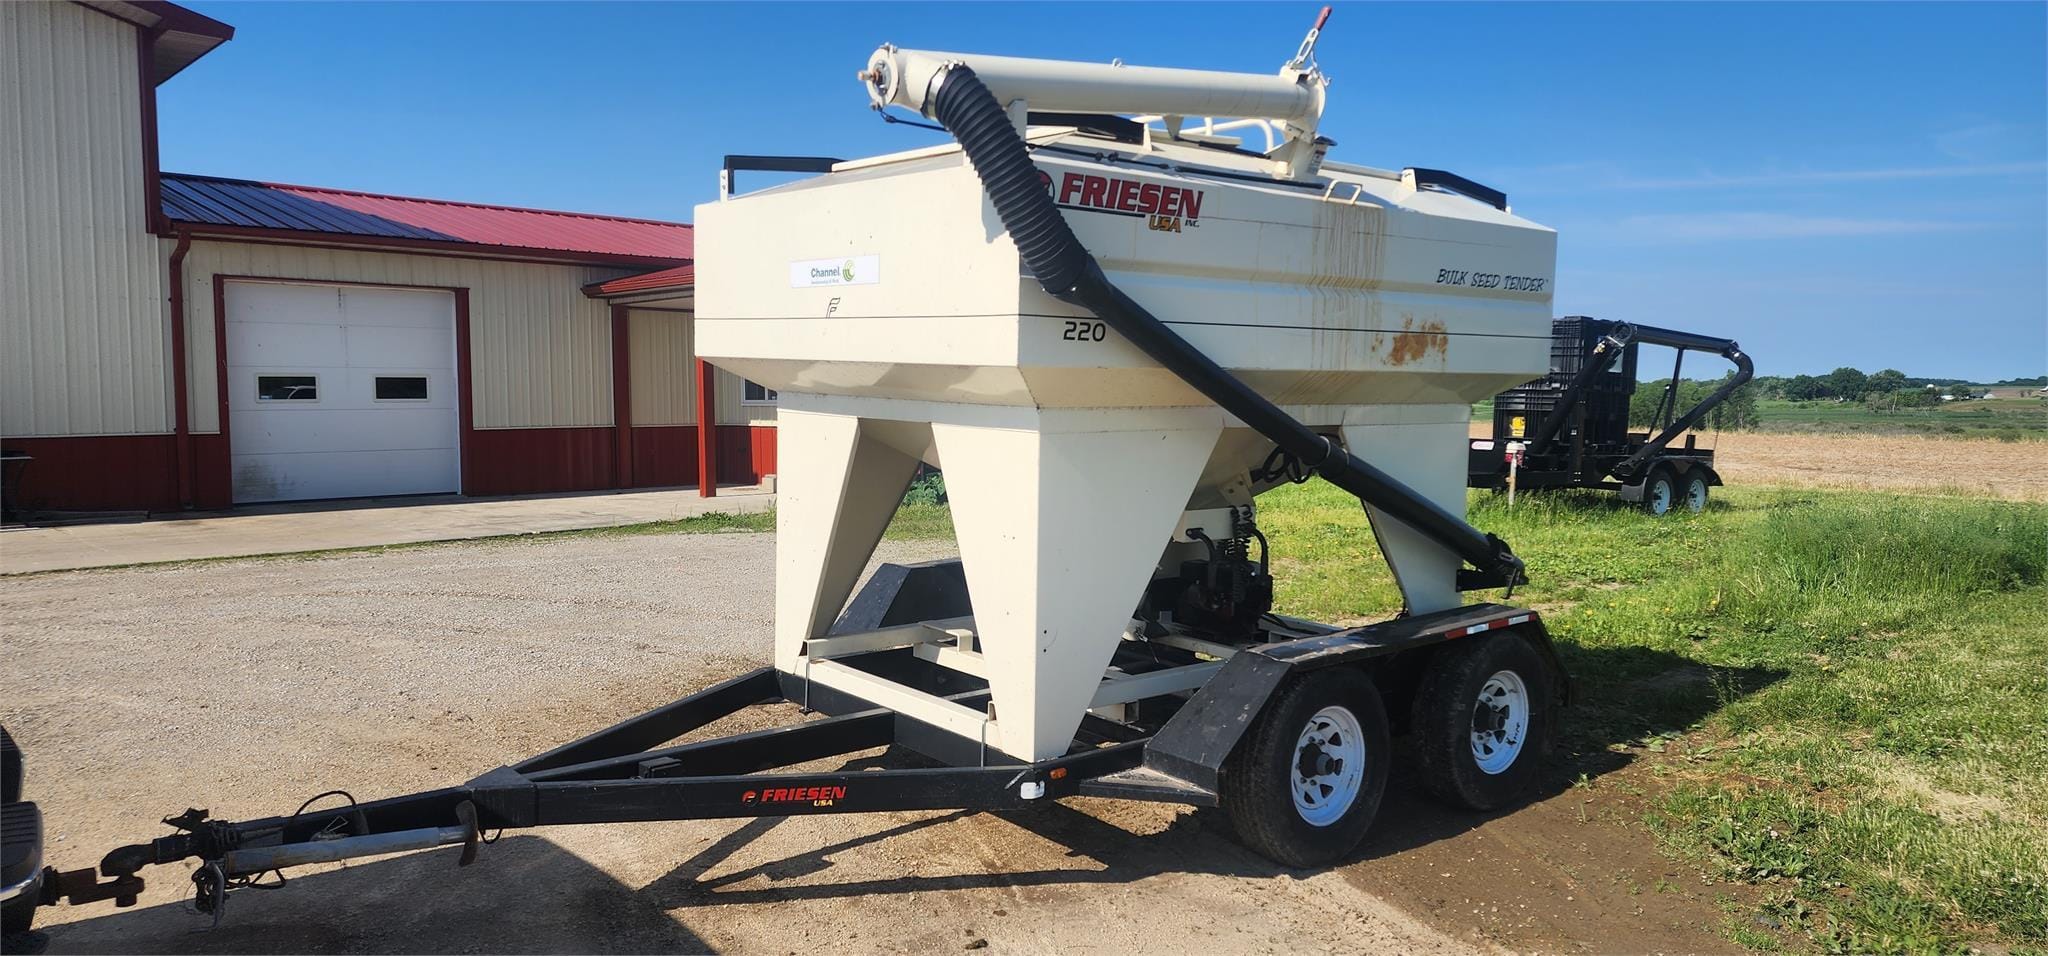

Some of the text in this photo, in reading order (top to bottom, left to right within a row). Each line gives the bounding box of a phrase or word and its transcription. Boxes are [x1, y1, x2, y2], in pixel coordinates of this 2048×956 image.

[1059, 172, 1204, 219] FRIESEN
[1149, 215, 1182, 233] USA
[1437, 269, 1545, 291] BULK SEED TENDER
[1064, 321, 1106, 342] 220
[761, 786, 847, 802] FRIESEN
[813, 799, 833, 807] USA
